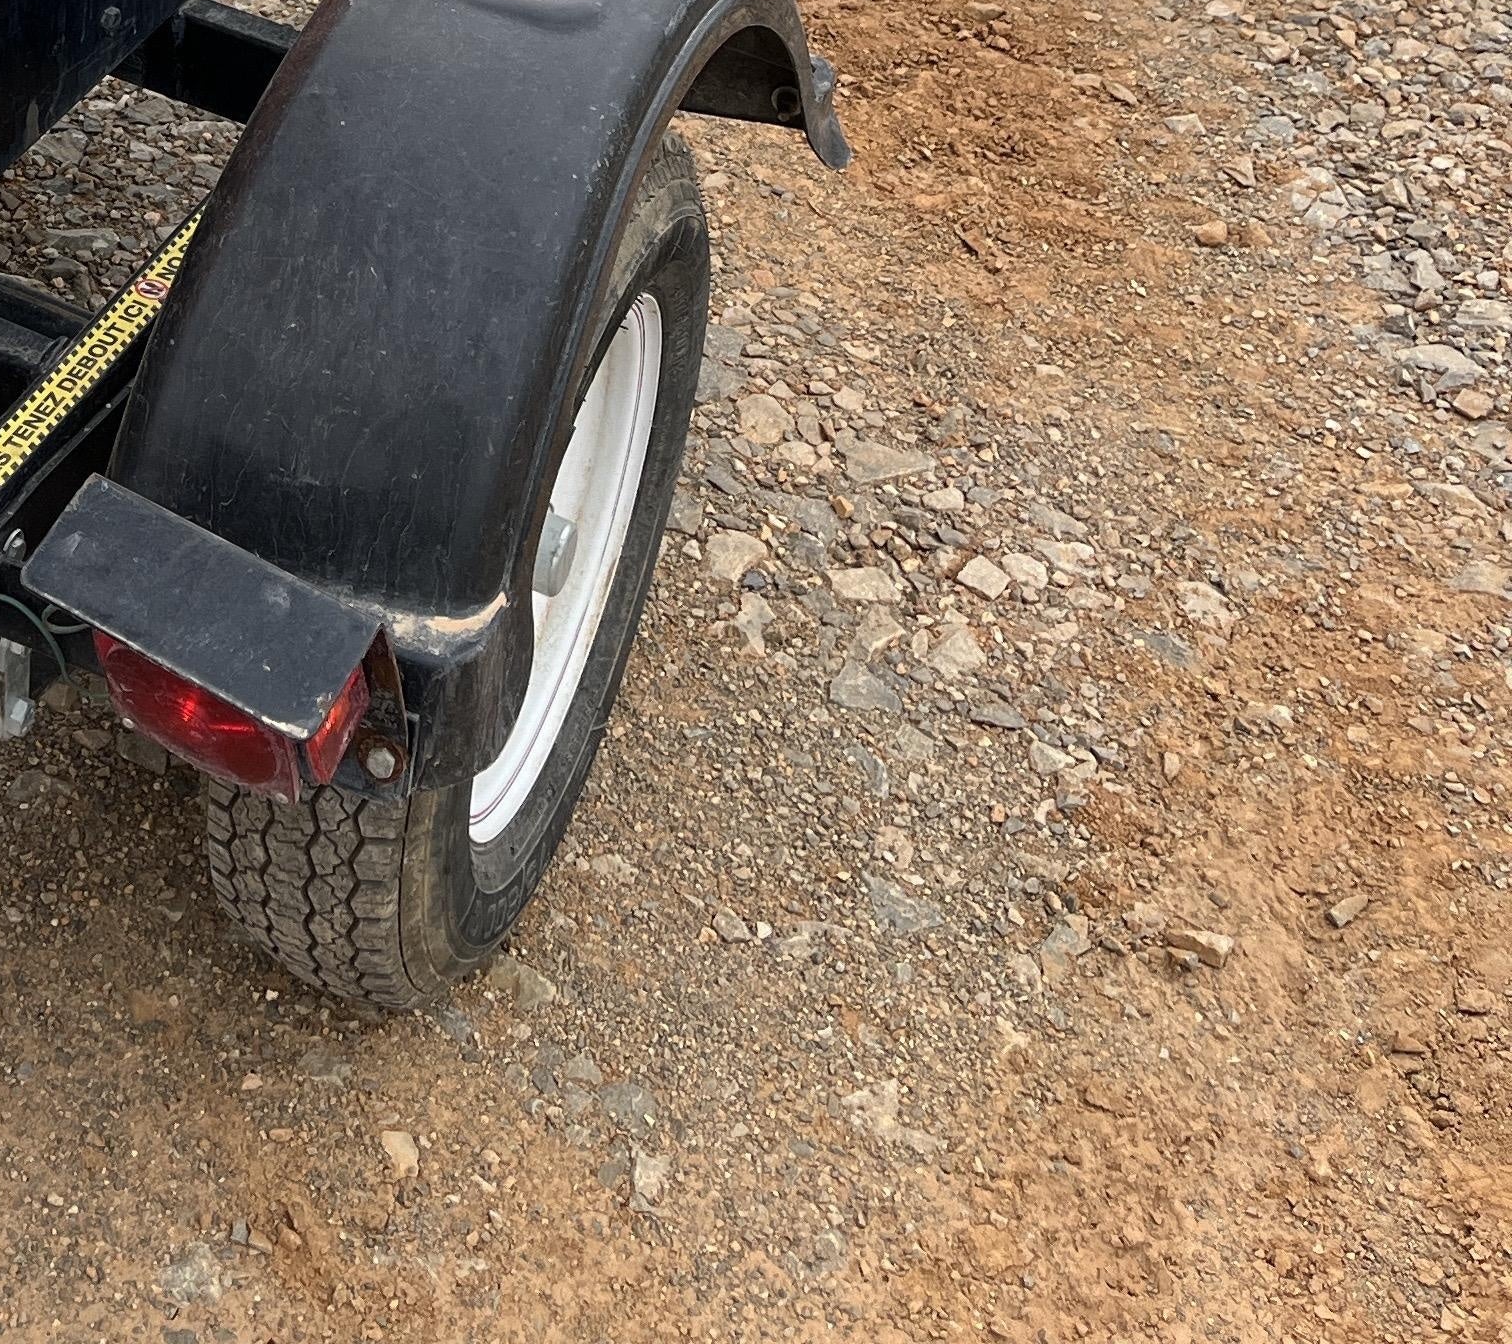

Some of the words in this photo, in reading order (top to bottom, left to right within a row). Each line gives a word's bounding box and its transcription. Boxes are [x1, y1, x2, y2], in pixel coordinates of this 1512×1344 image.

[5, 388, 66, 452] TENEZ
[54, 317, 127, 395] DEBOUT
[119, 298, 148, 328] ICI
